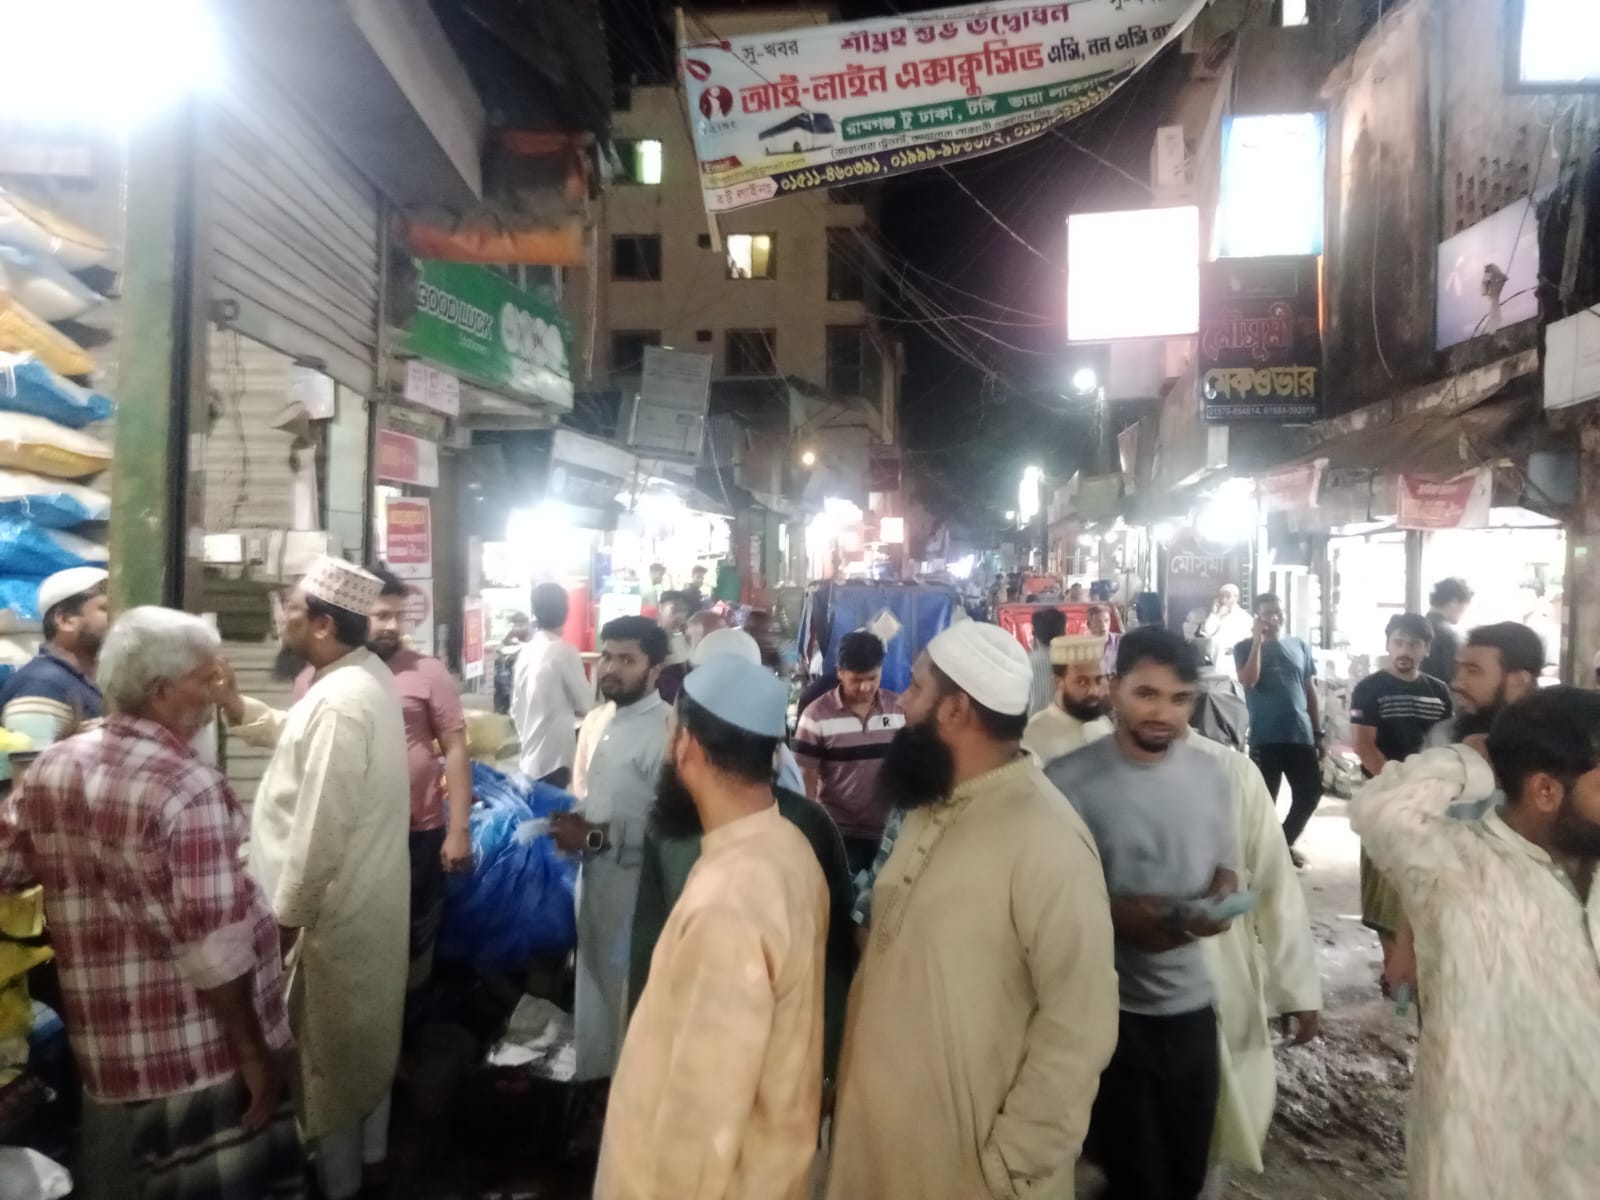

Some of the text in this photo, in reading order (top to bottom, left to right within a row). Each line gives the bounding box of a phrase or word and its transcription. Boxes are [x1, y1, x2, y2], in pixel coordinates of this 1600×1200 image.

[739, 63, 888, 114] আই-লাইন
[1115, 25, 1148, 50] এসি
[900, 110, 914, 130] টু
